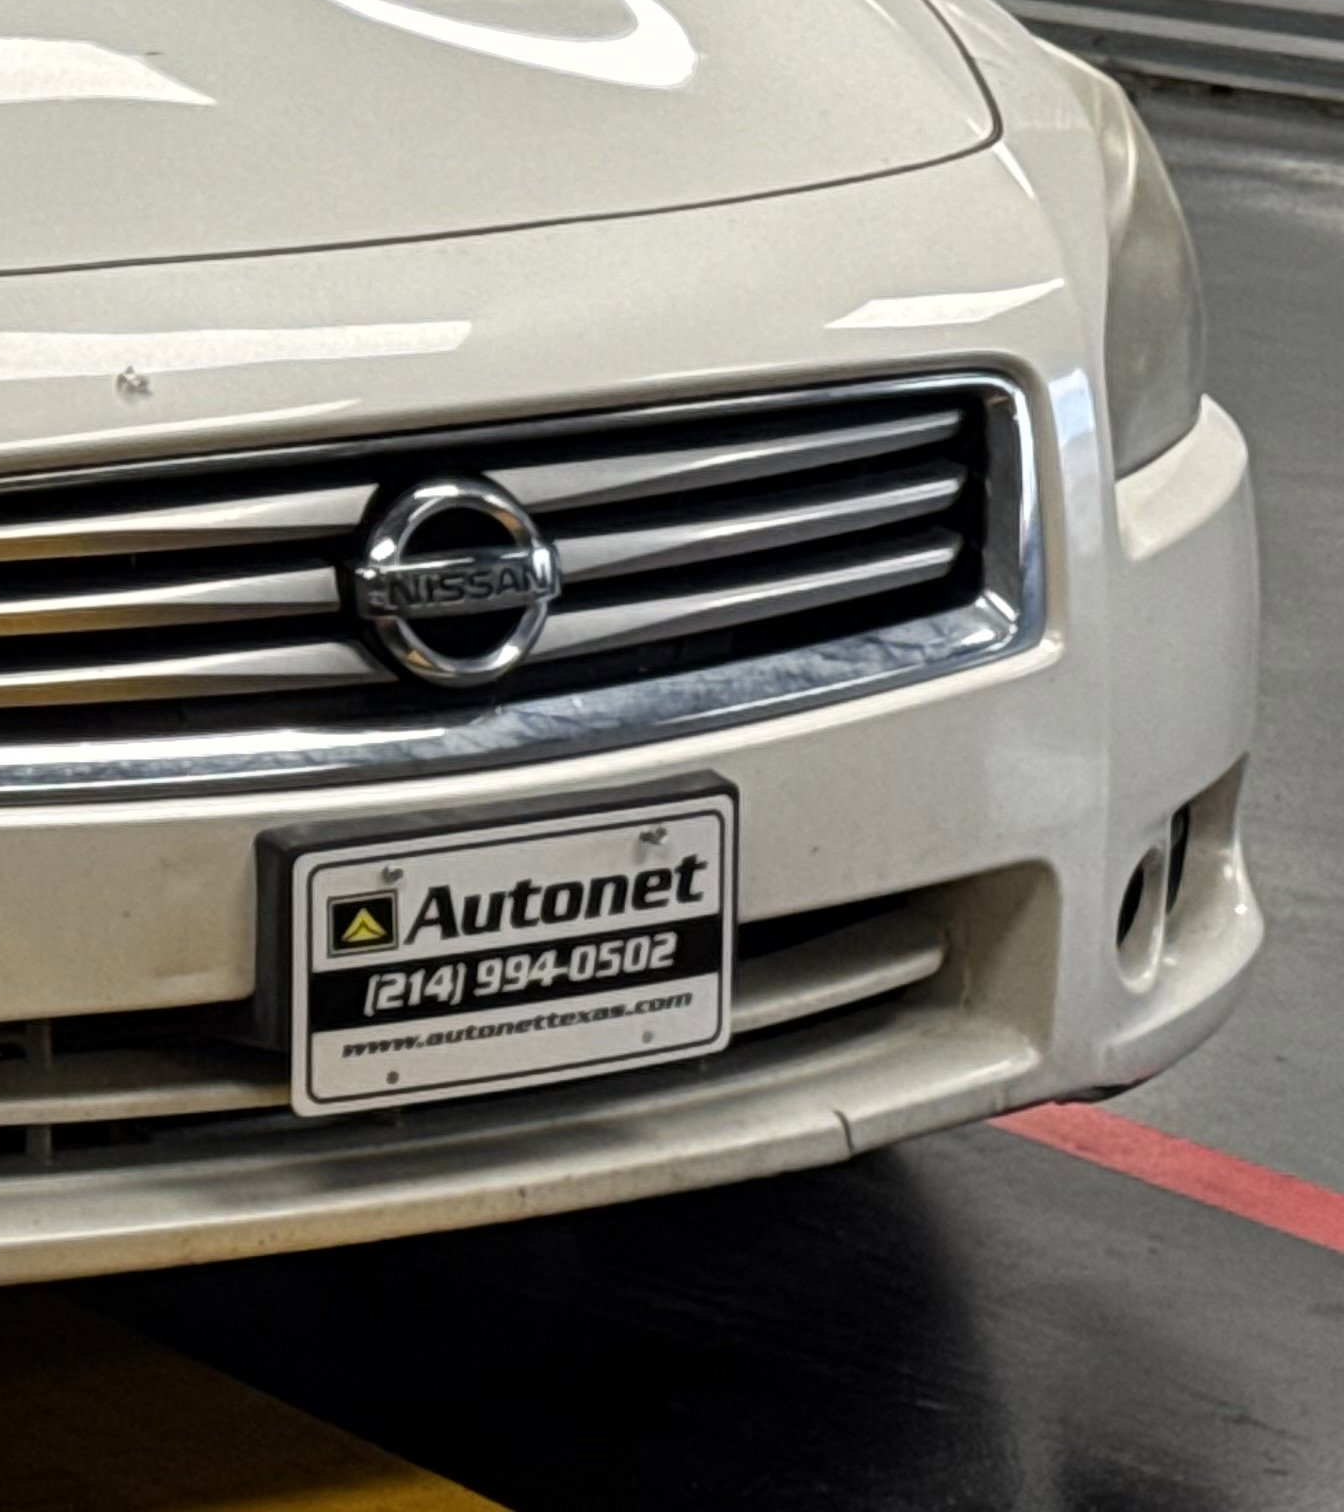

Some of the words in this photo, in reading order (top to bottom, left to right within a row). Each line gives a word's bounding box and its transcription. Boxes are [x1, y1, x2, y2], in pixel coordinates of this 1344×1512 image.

[388, 564, 551, 605] NISSAN
[404, 854, 709, 946] Autonet
[364, 962, 466, 1017] (214)
[473, 931, 678, 996] 994-0502
[341, 991, 693, 1058] www.autonettexas.com
